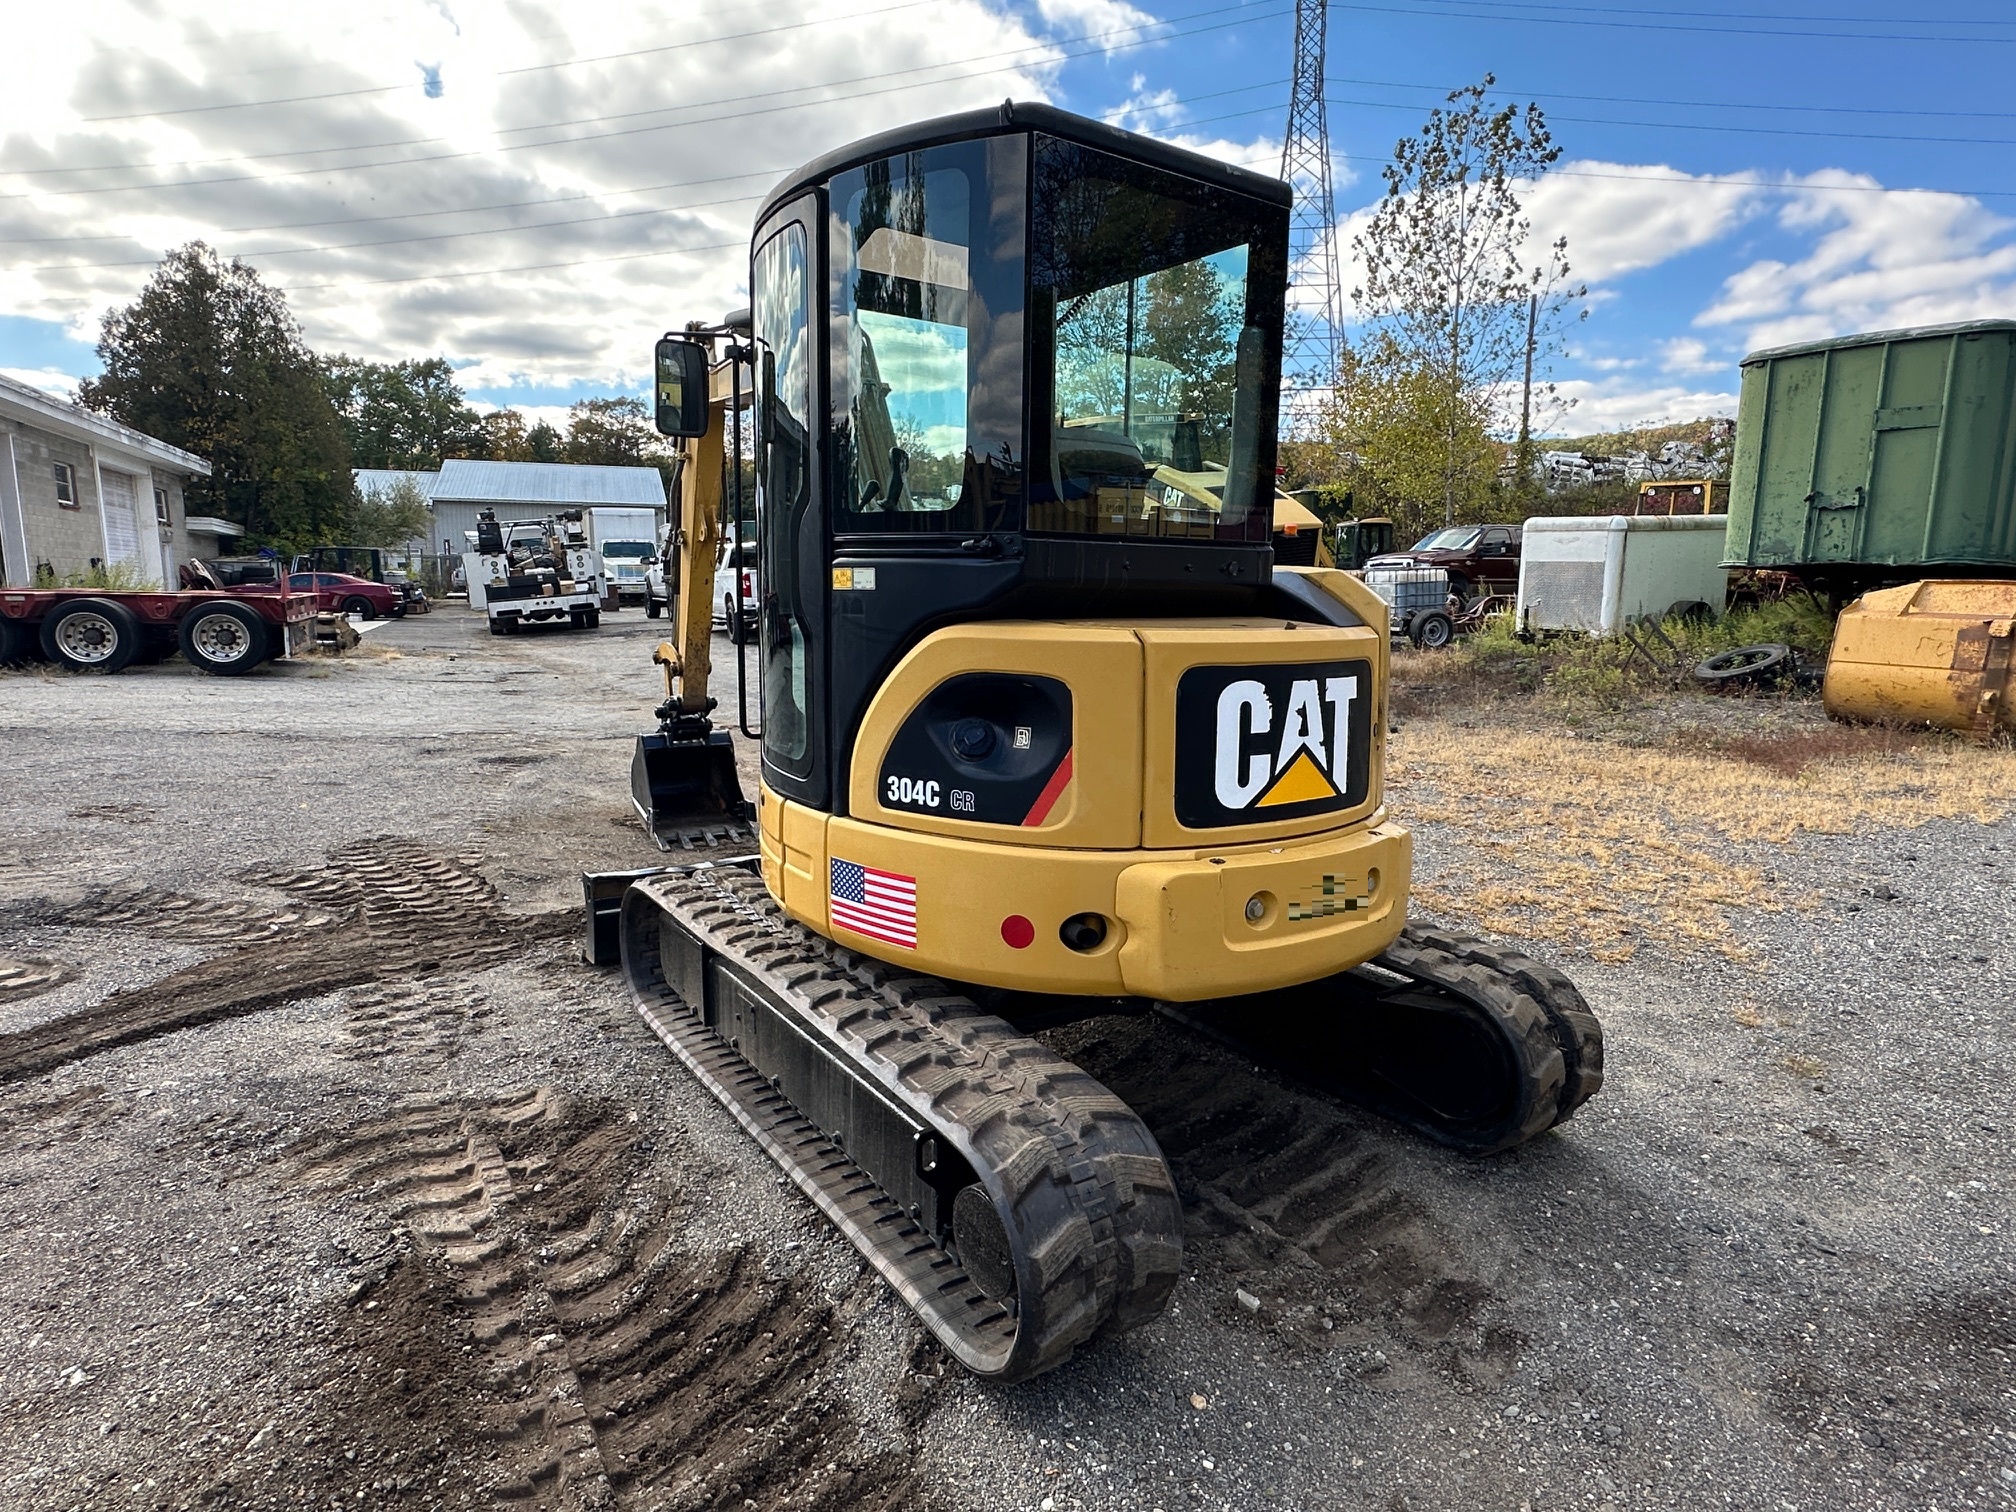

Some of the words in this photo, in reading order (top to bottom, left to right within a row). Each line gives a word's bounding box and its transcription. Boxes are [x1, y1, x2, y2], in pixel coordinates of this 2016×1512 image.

[1163, 486, 1184, 507] CAT
[1215, 676, 1357, 810] CAT
[887, 775, 940, 807] 304C
[950, 789, 975, 812] CR
